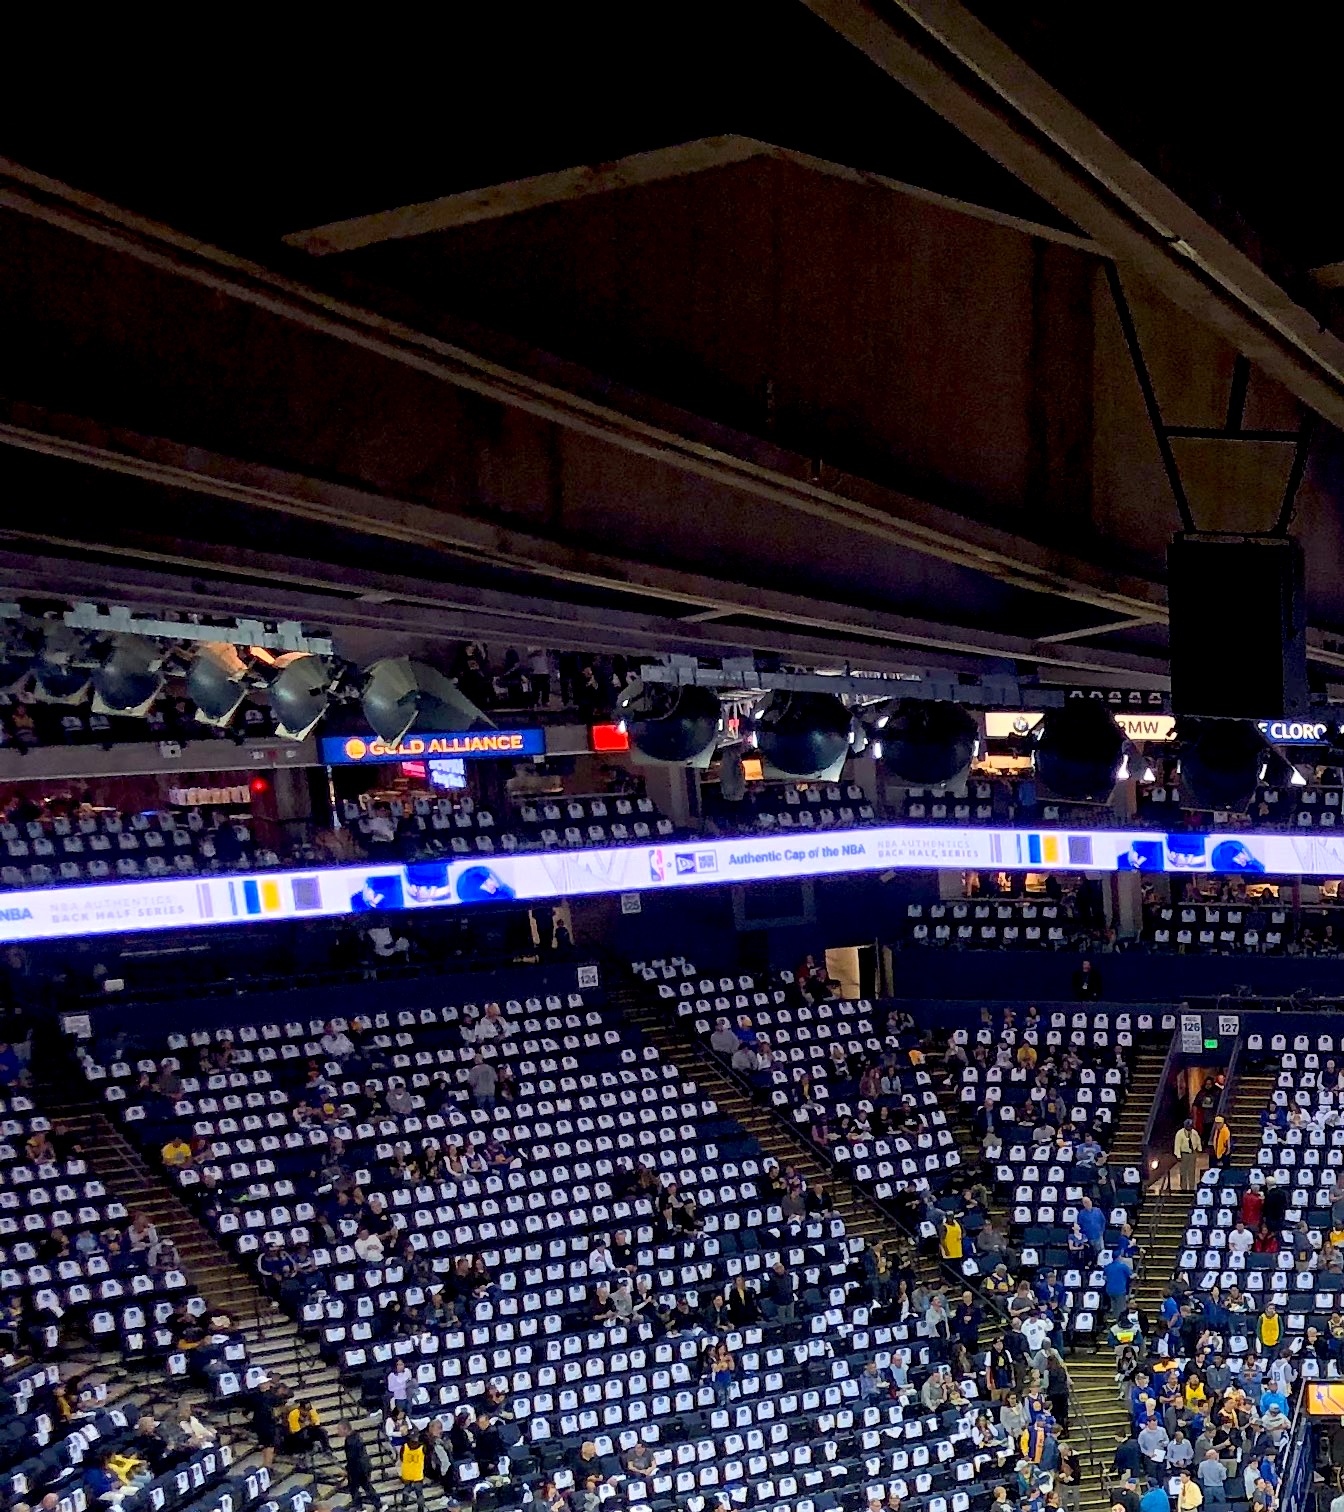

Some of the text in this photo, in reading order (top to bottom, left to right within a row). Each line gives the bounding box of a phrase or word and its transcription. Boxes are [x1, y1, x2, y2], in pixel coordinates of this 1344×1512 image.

[1269, 723, 1327, 739] CLORO
[428, 734, 524, 753] ALLIANCE
[728, 849, 782, 866] Authentic
[784, 848, 806, 864] Cap
[808, 846, 820, 859] of
[822, 845, 840, 859] the
[841, 843, 866, 857] NBA
[52, 904, 185, 924] BACK HALF SERIES
[1183, 1022, 1201, 1032] 126
[1220, 1023, 1238, 1033] 127
